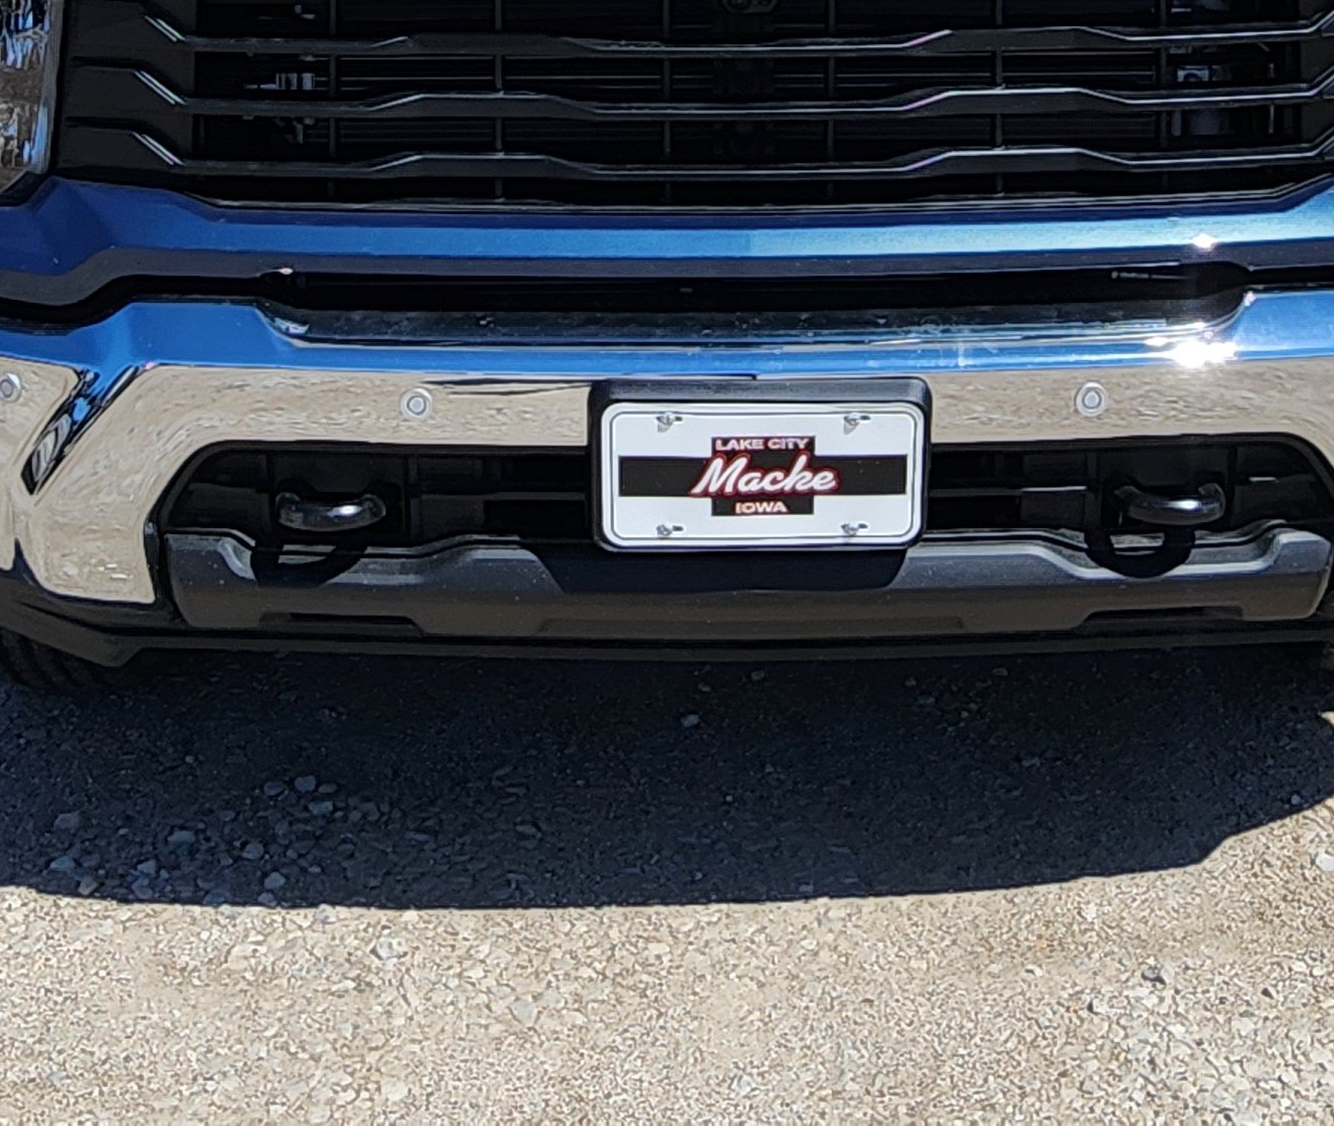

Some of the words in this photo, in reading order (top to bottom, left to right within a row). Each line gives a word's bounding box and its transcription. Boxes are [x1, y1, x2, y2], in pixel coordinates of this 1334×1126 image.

[715, 438, 764, 451] LAKE
[767, 437, 810, 450] CITY
[689, 452, 839, 495] Macke
[735, 501, 788, 514] IOWA
